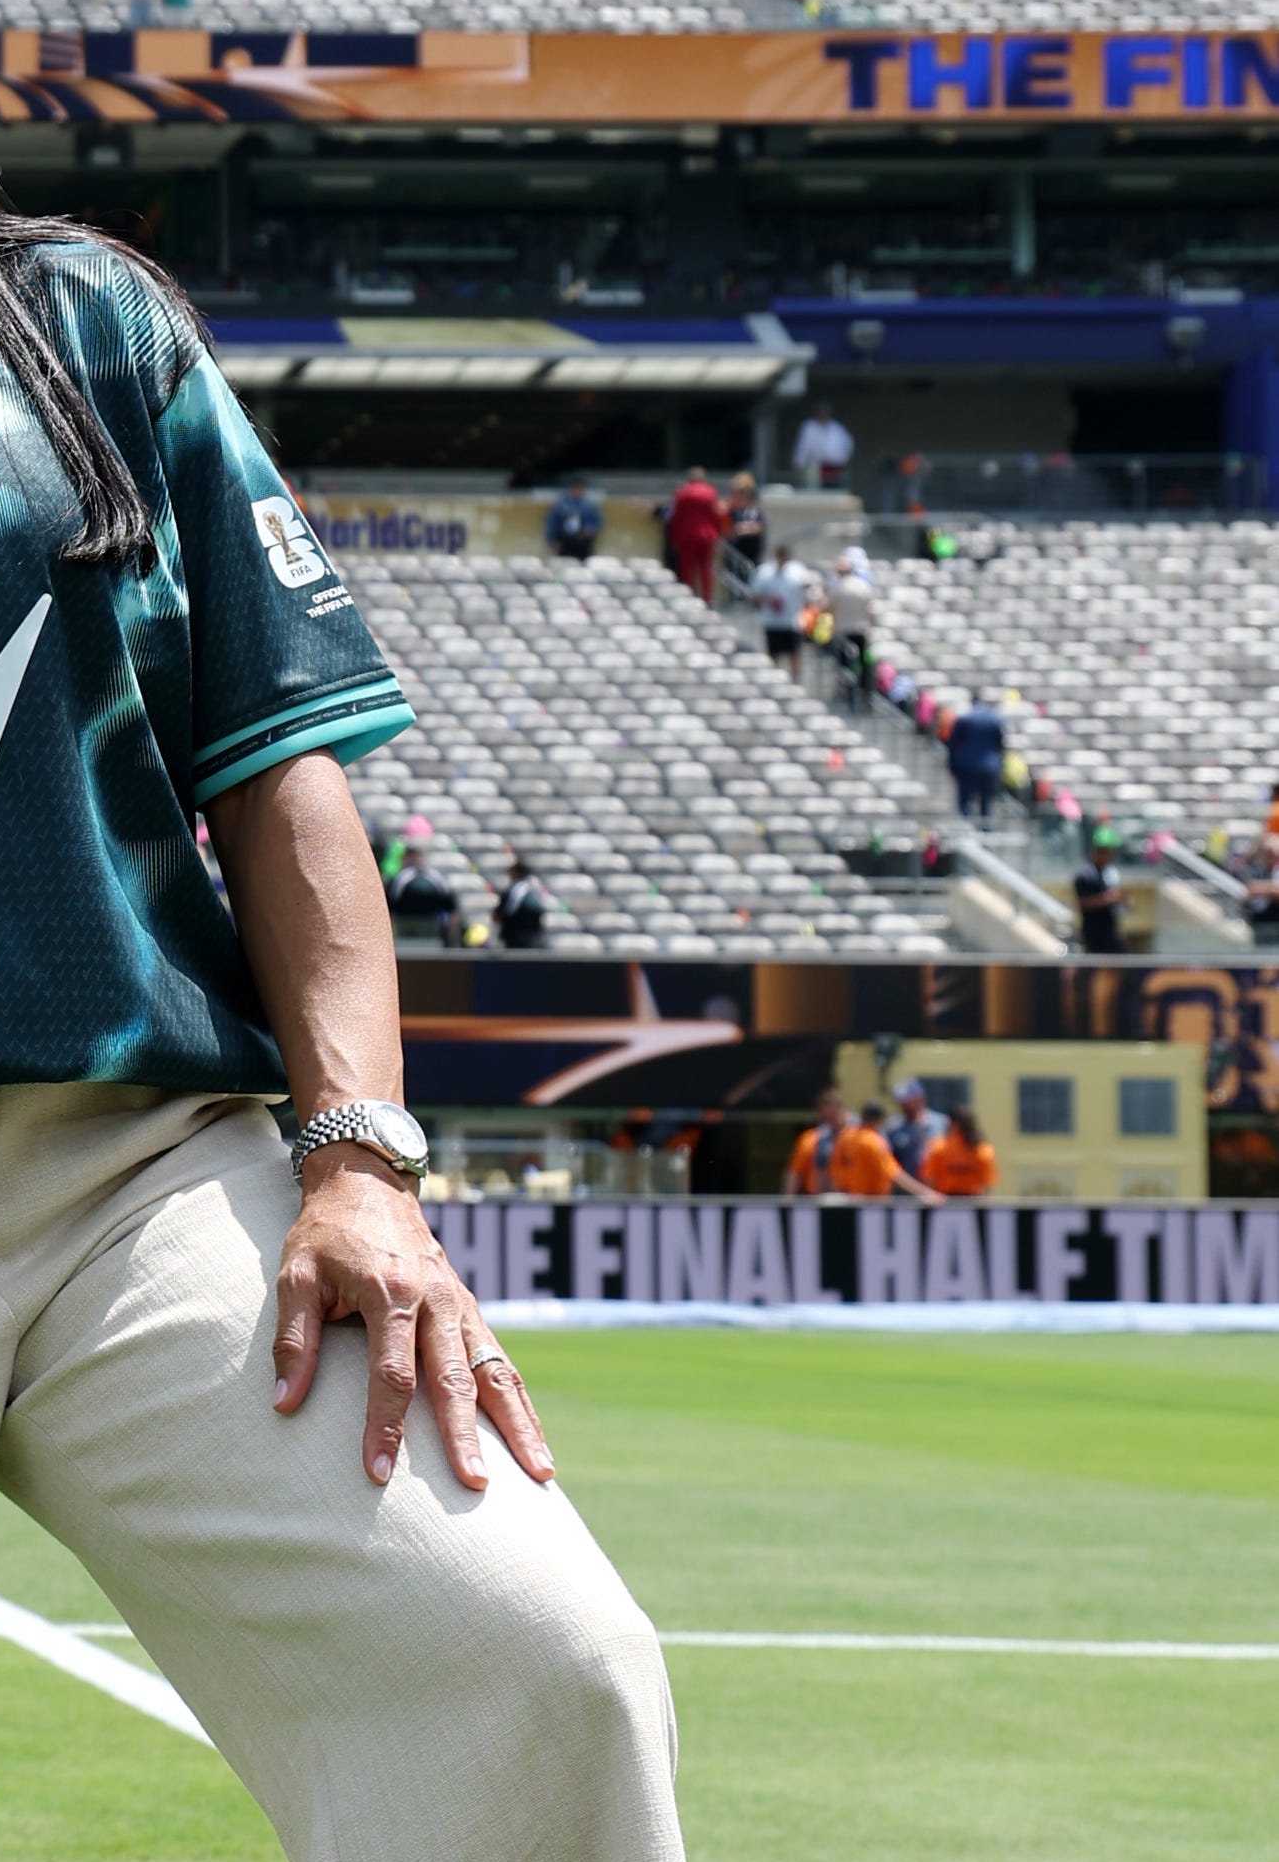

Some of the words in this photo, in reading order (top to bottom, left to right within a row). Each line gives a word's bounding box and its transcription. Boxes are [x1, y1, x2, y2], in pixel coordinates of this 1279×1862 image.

[824, 39, 1072, 110] THE
[290, 564, 312, 579] FIFA
[306, 603, 327, 618] THE
[421, 1204, 555, 1302] HE
[573, 1204, 841, 1303] FINAL
[858, 1209, 1090, 1302] HALF
